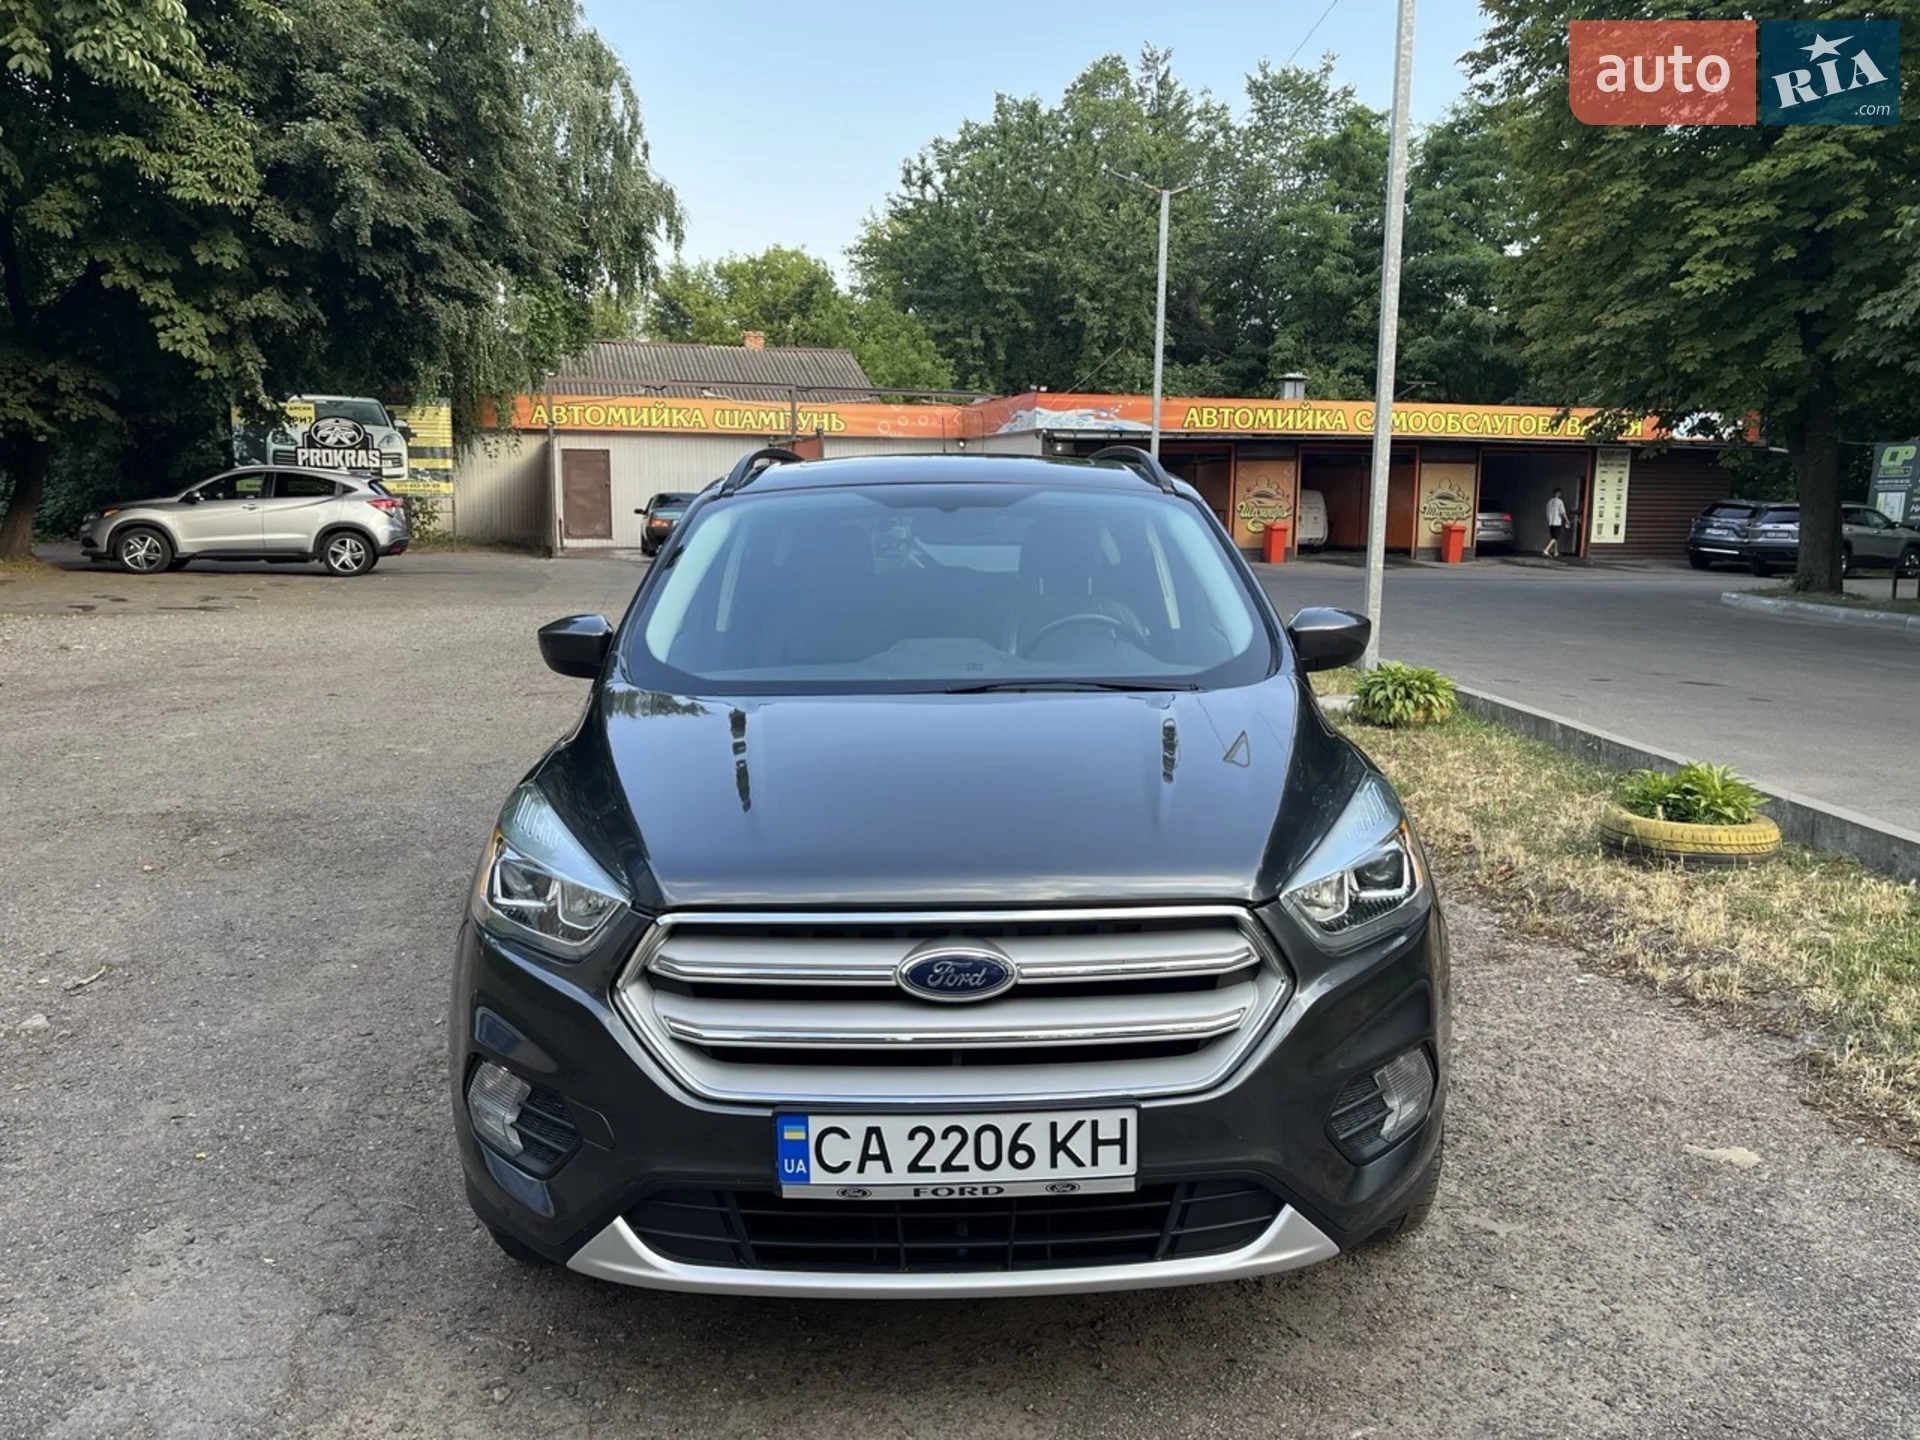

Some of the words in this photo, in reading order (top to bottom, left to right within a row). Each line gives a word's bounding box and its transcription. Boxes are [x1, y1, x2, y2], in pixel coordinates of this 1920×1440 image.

[530, 401, 706, 429] АВТОМИЙКА
[1182, 402, 1348, 431] АВТОМИЙКА
[1354, 409, 1642, 438] СМООБСЛУГОВВЯ
[296, 448, 380, 468] PROKRAS
[926, 960, 987, 987] Ford
[783, 1159, 807, 1175] UA
[813, 1125, 893, 1176] CA
[906, 1121, 1036, 1175] 2206
[1048, 1117, 1129, 1170] KH
[912, 1185, 1005, 1198] FORD
